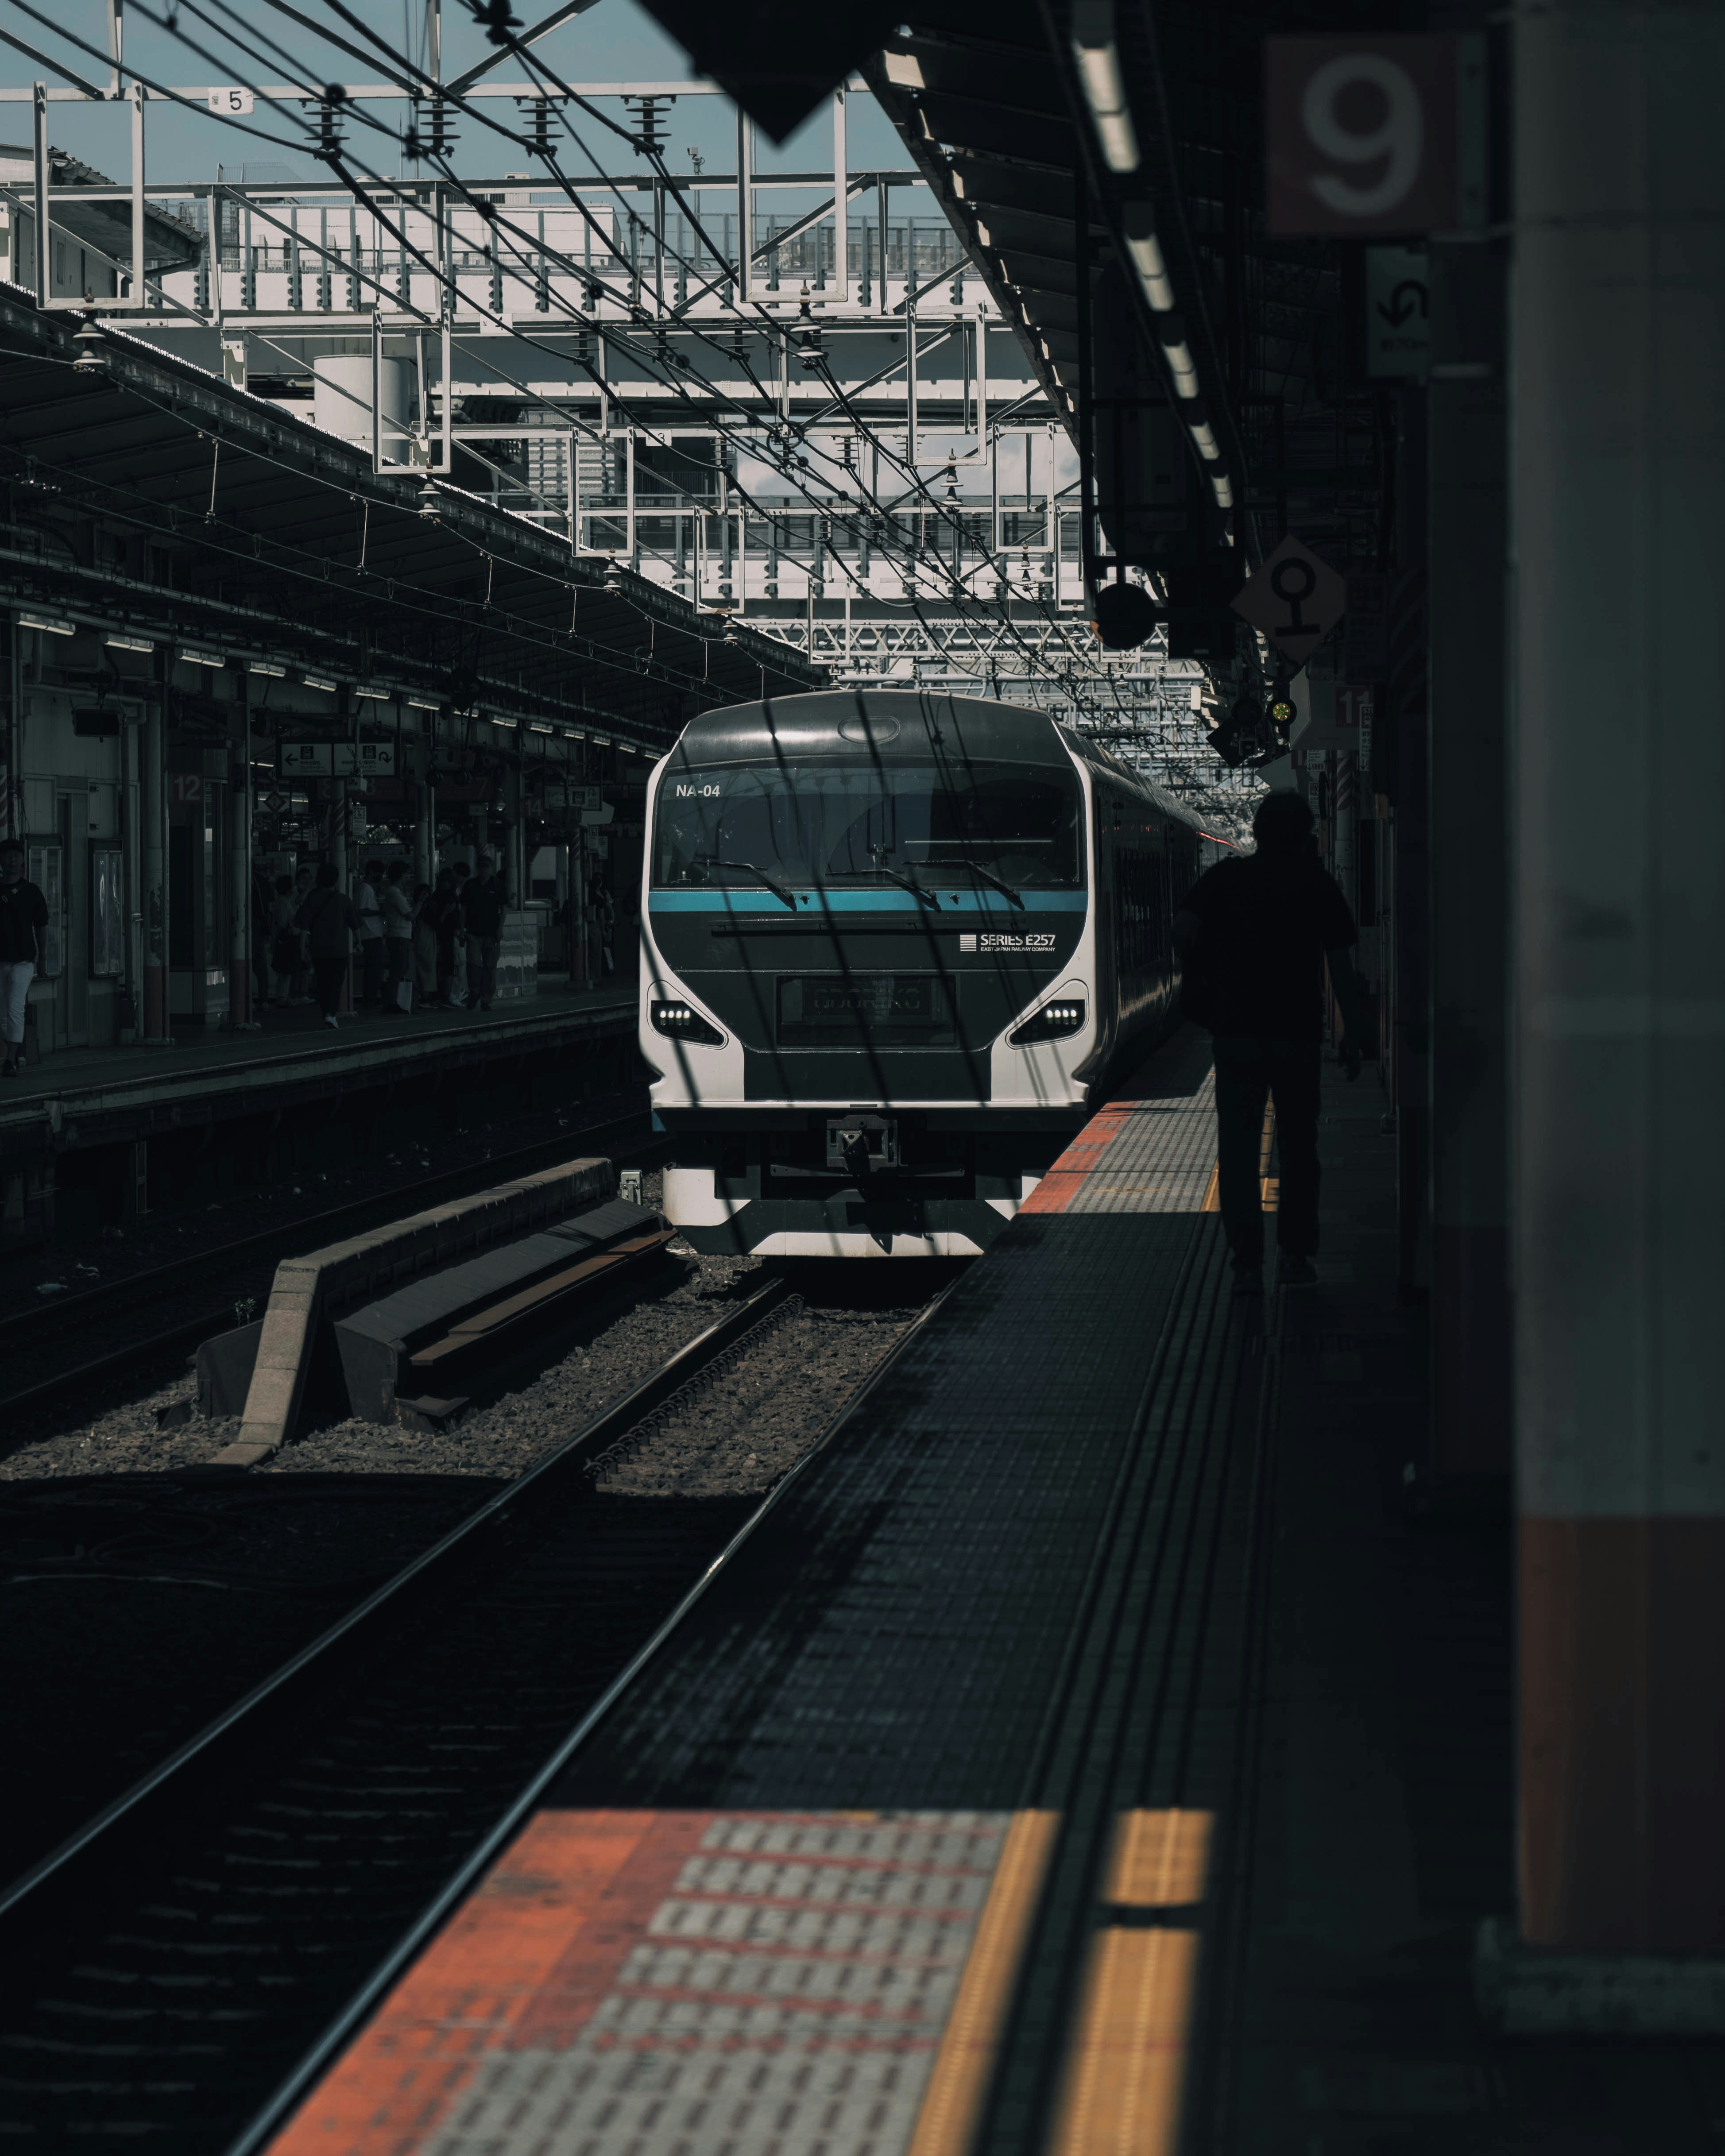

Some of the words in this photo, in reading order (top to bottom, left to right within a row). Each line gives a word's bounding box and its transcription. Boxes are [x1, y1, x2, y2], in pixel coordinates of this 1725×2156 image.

[229, 91, 242, 110] 5
[1301, 53, 1423, 216] 9
[174, 775, 201, 801] 12
[676, 784, 720, 797] NA-04
[525, 799, 542, 816] 14
[981, 935, 1023, 946] SERIES
[1025, 935, 1056, 946] E257
